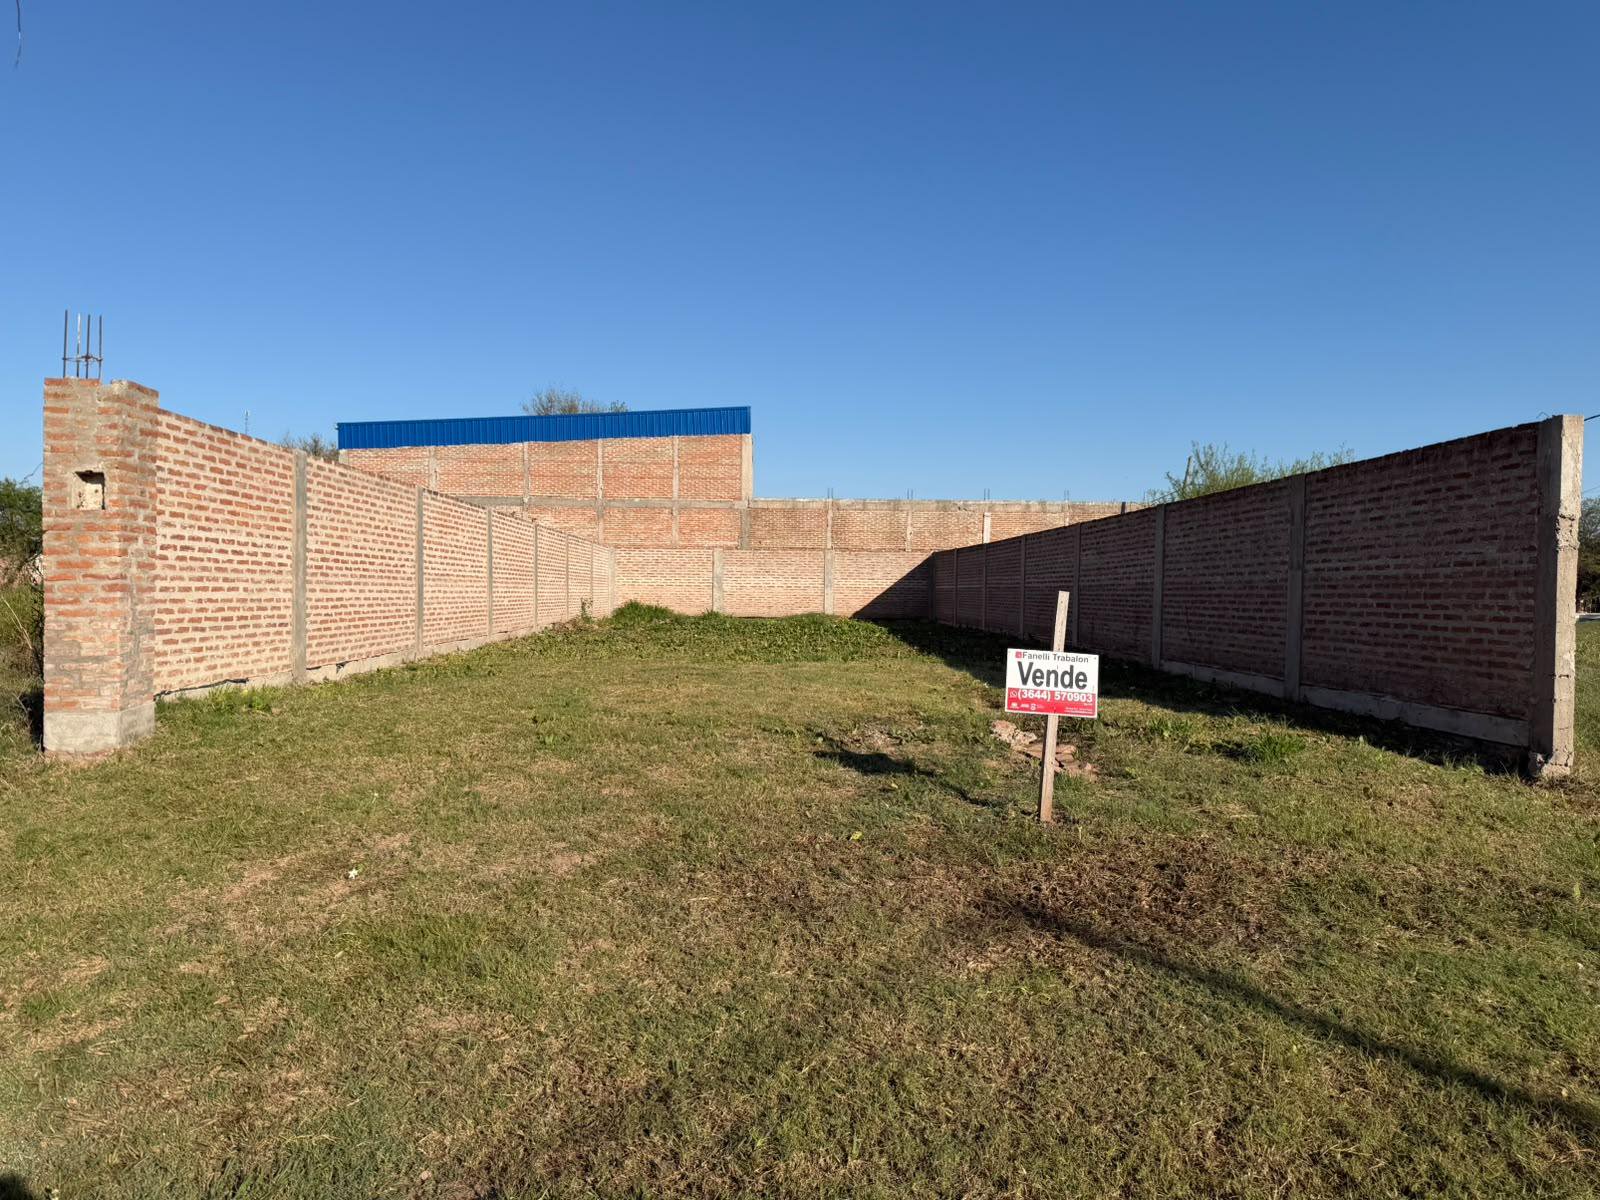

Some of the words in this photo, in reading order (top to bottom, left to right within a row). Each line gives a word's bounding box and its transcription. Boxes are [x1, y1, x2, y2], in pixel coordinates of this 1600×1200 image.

[1022, 651, 1050, 661] Fanelli
[1052, 653, 1089, 663] Trabalon
[1017, 660, 1088, 690] Vende
[1017, 689, 1051, 702] (3644)
[1054, 692, 1093, 703] 570903
